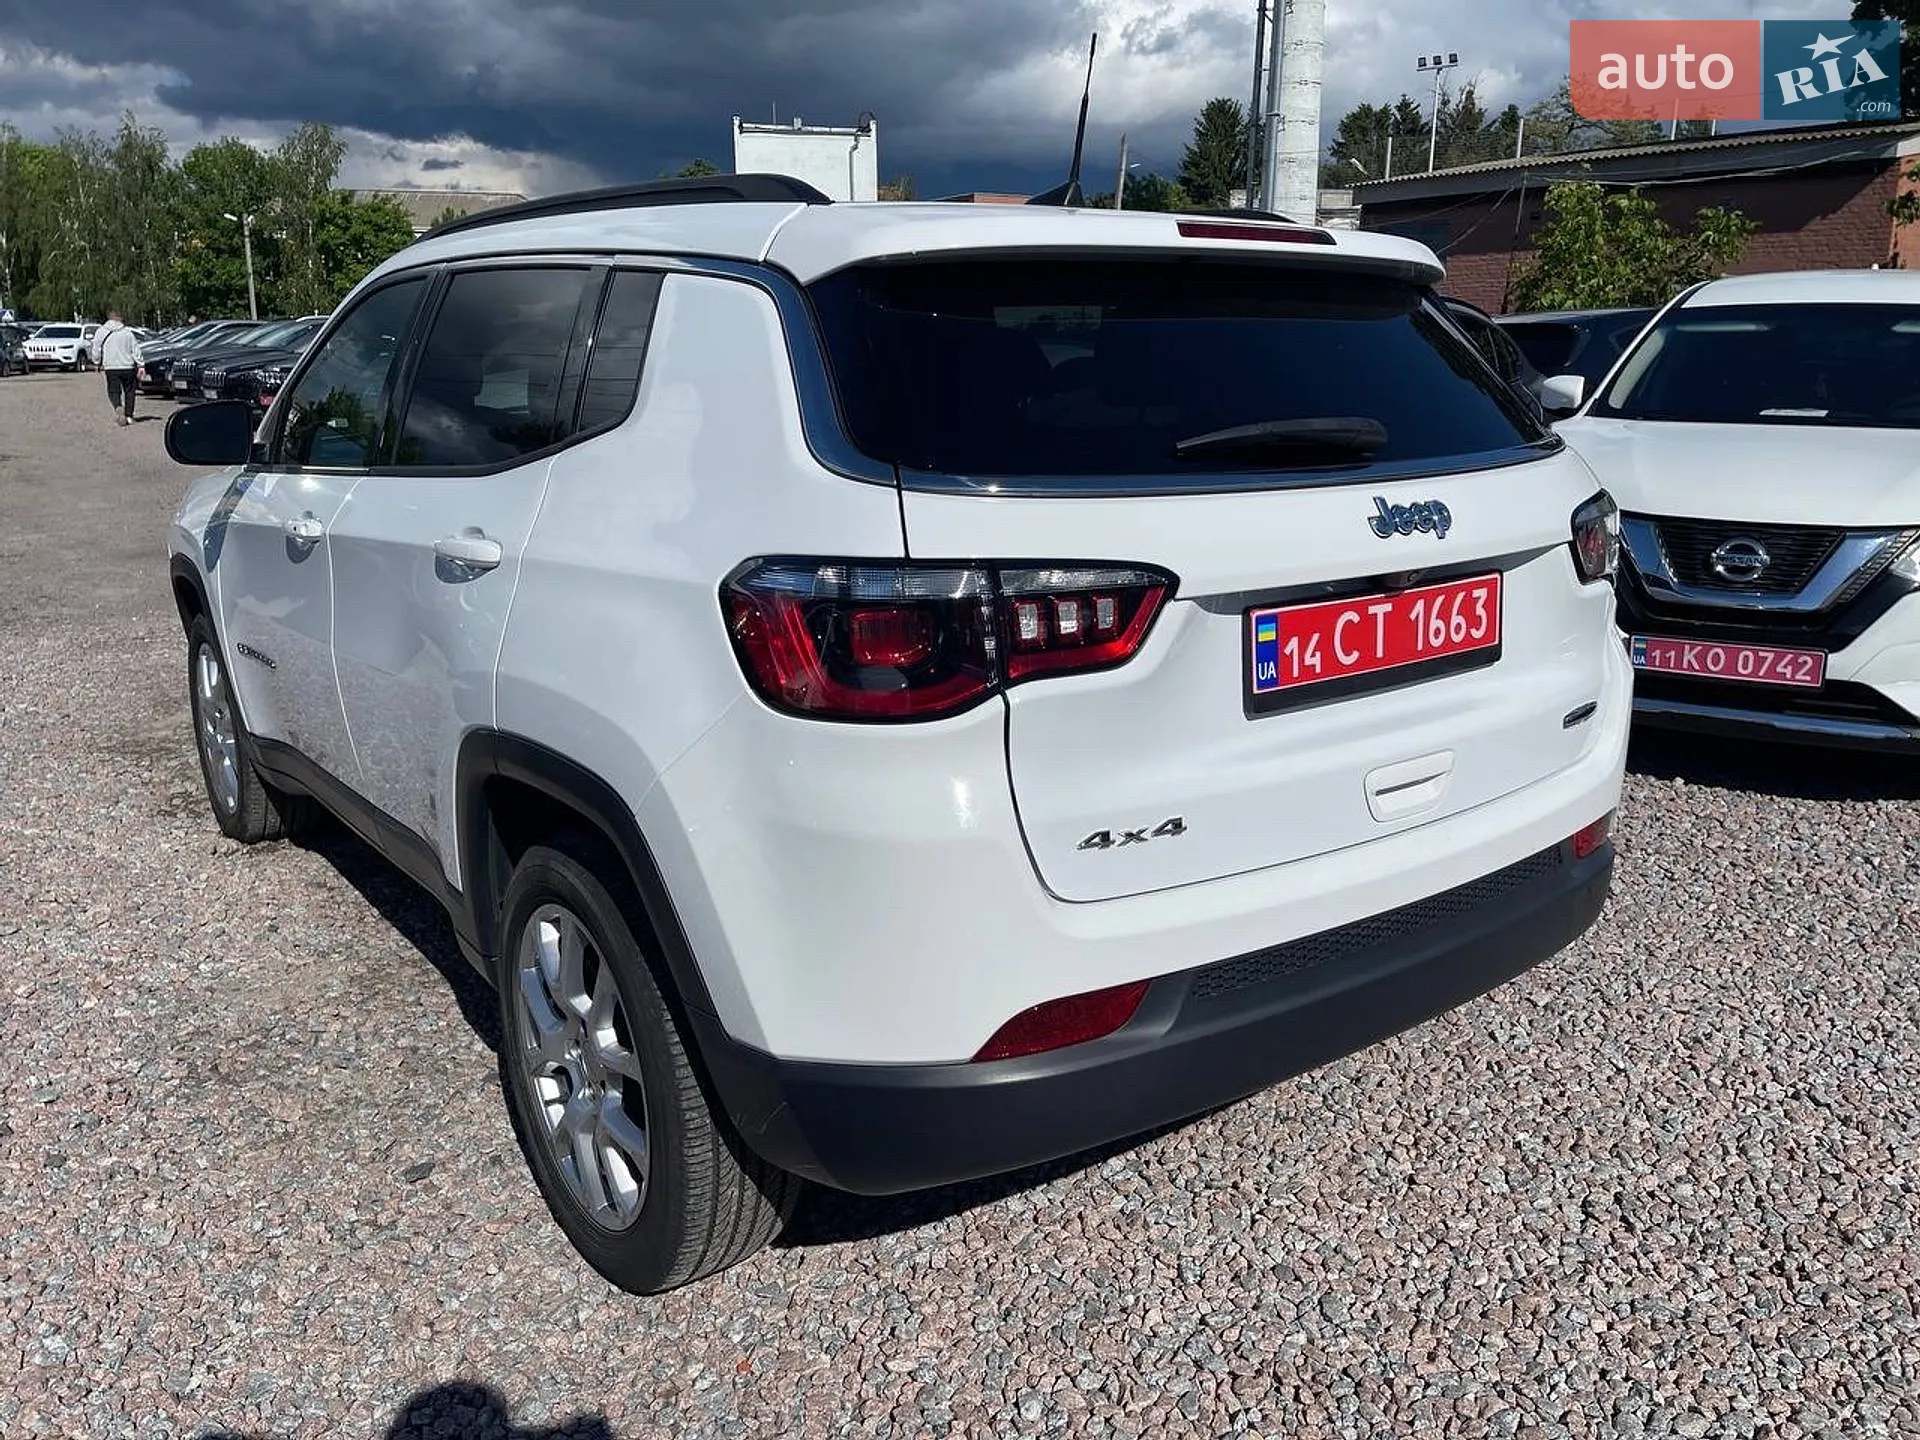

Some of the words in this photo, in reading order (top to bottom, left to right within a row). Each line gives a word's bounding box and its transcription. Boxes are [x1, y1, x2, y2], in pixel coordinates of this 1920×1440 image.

[1366, 496, 1452, 539] Jeep
[1408, 589, 1488, 651] 1663
[1258, 661, 1277, 680] UA
[1633, 655, 1646, 666] UA
[1736, 650, 1813, 681] 0742
